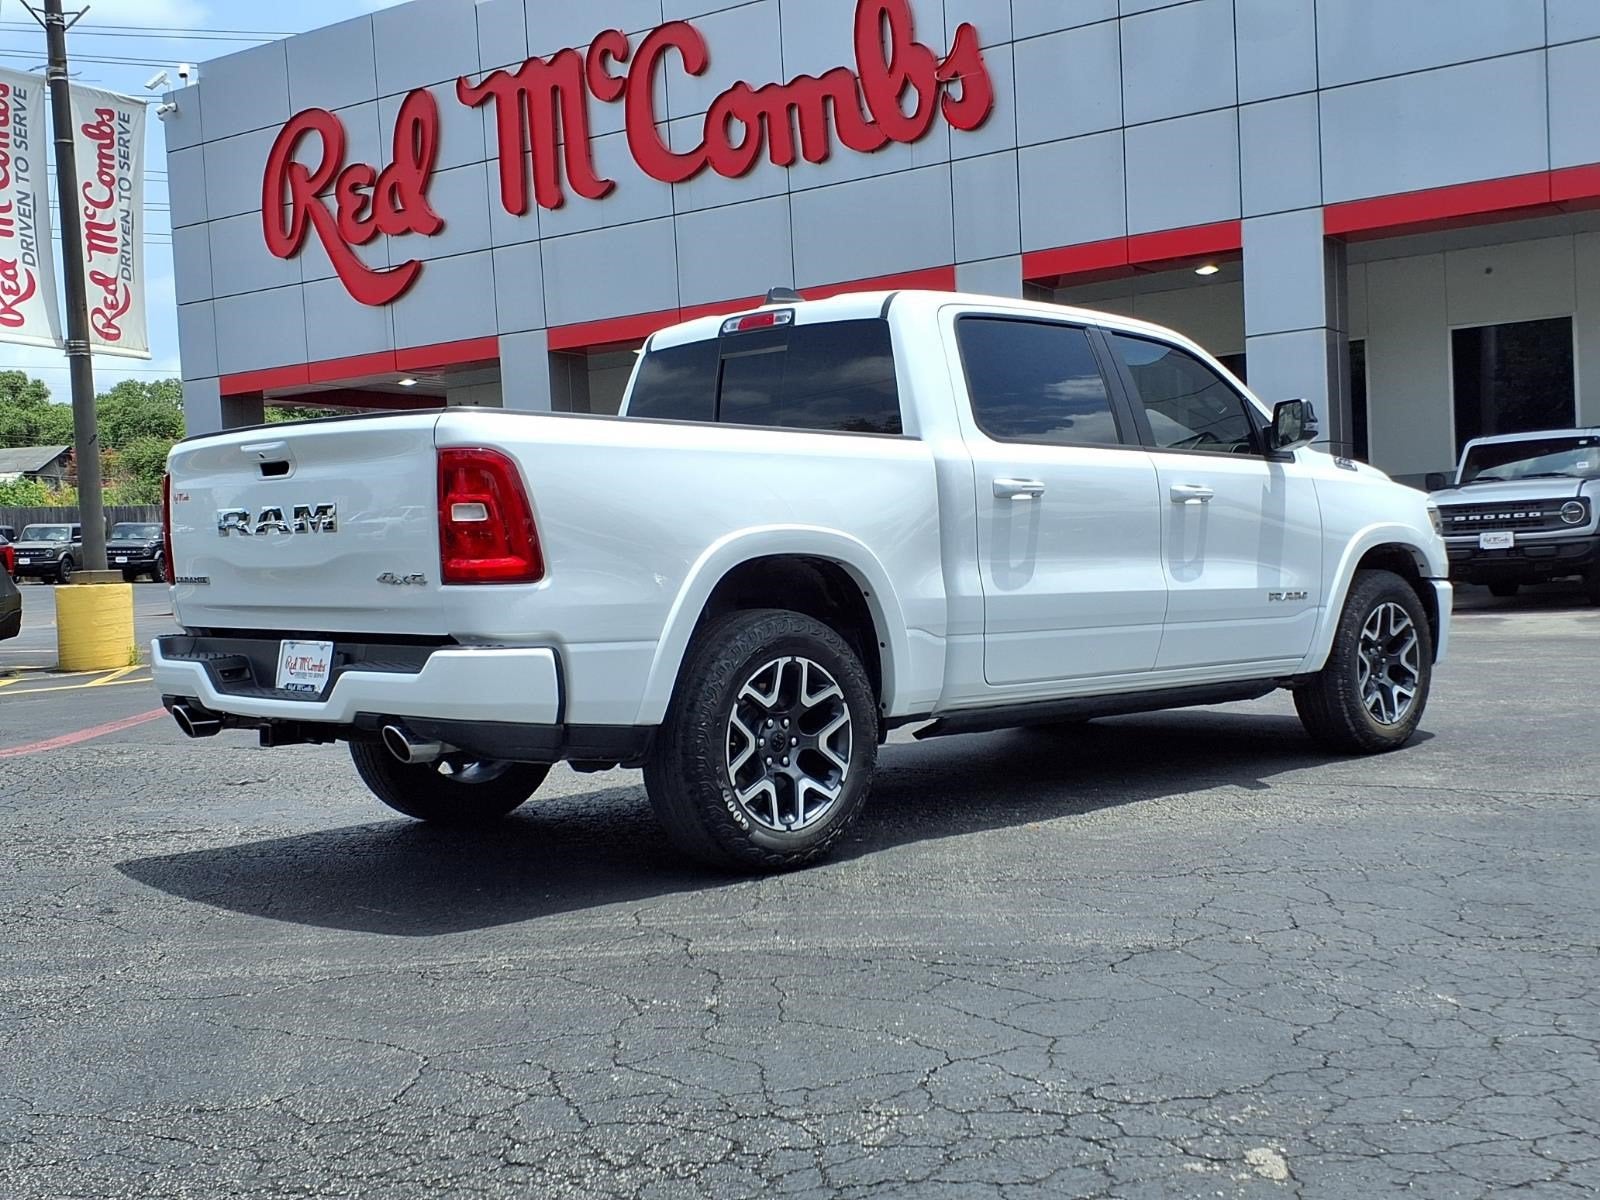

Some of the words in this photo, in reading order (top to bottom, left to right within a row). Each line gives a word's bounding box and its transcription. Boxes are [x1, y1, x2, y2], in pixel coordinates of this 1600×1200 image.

[12, 85, 28, 151] SERVE
[118, 110, 131, 172] SERVE
[14, 156, 30, 184] TO
[81, 107, 118, 262] McCombs
[262, 88, 445, 306] Red
[456, 0, 994, 217] McCombs
[118, 177, 132, 203] TO
[16, 190, 37, 268] DRIVEN
[119, 208, 132, 282] DRIVEN
[89, 269, 131, 341] Red
[217, 503, 338, 537] RAM
[1453, 511, 1541, 522] BRONCO
